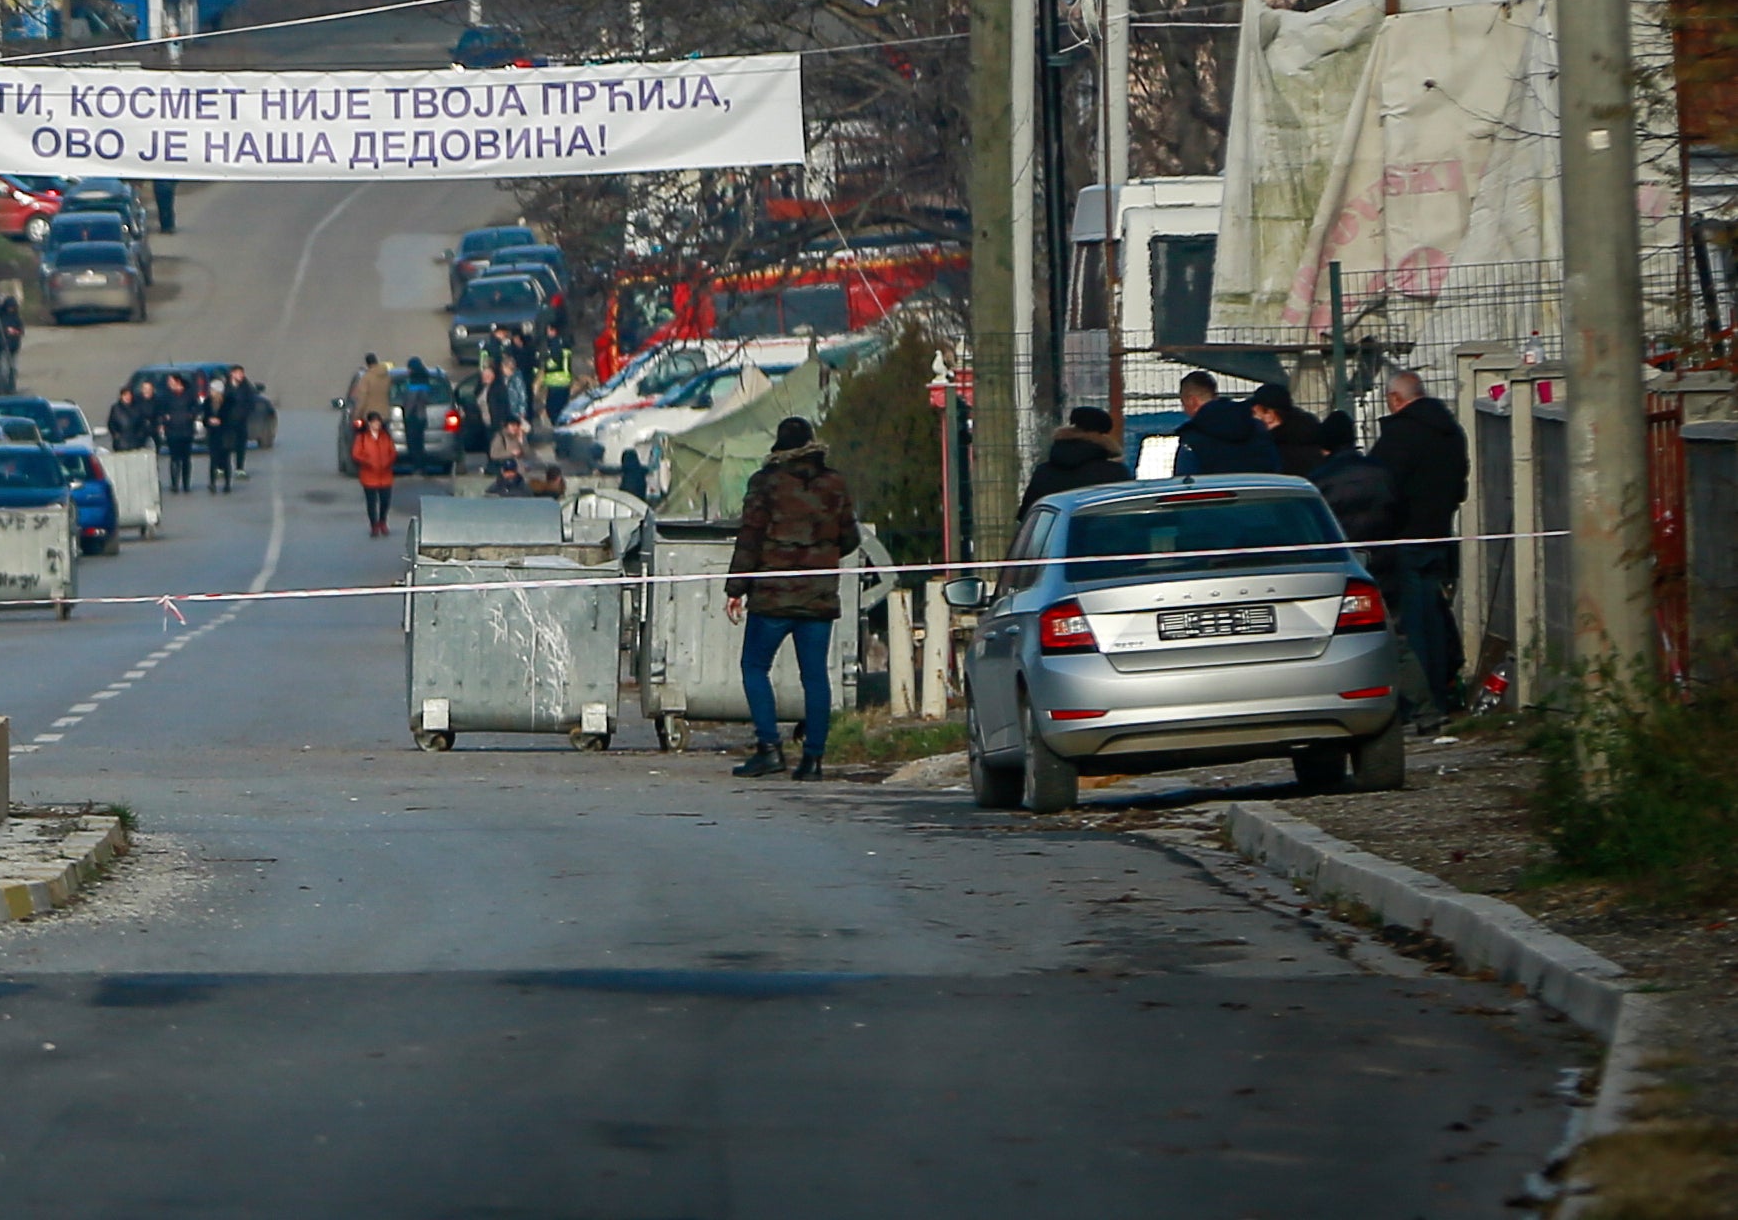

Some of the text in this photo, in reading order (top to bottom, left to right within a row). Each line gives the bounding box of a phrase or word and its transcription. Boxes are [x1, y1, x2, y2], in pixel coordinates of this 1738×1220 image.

[70, 86, 247, 120] КОСМЕТ
[261, 88, 371, 121] НИЈЕ
[384, 84, 528, 119] ТВОЈА
[541, 75, 731, 114] ПРЋИЈА,
[31, 125, 607, 169] ОВО ЈЕ НАША ДЕДОВИНА!
